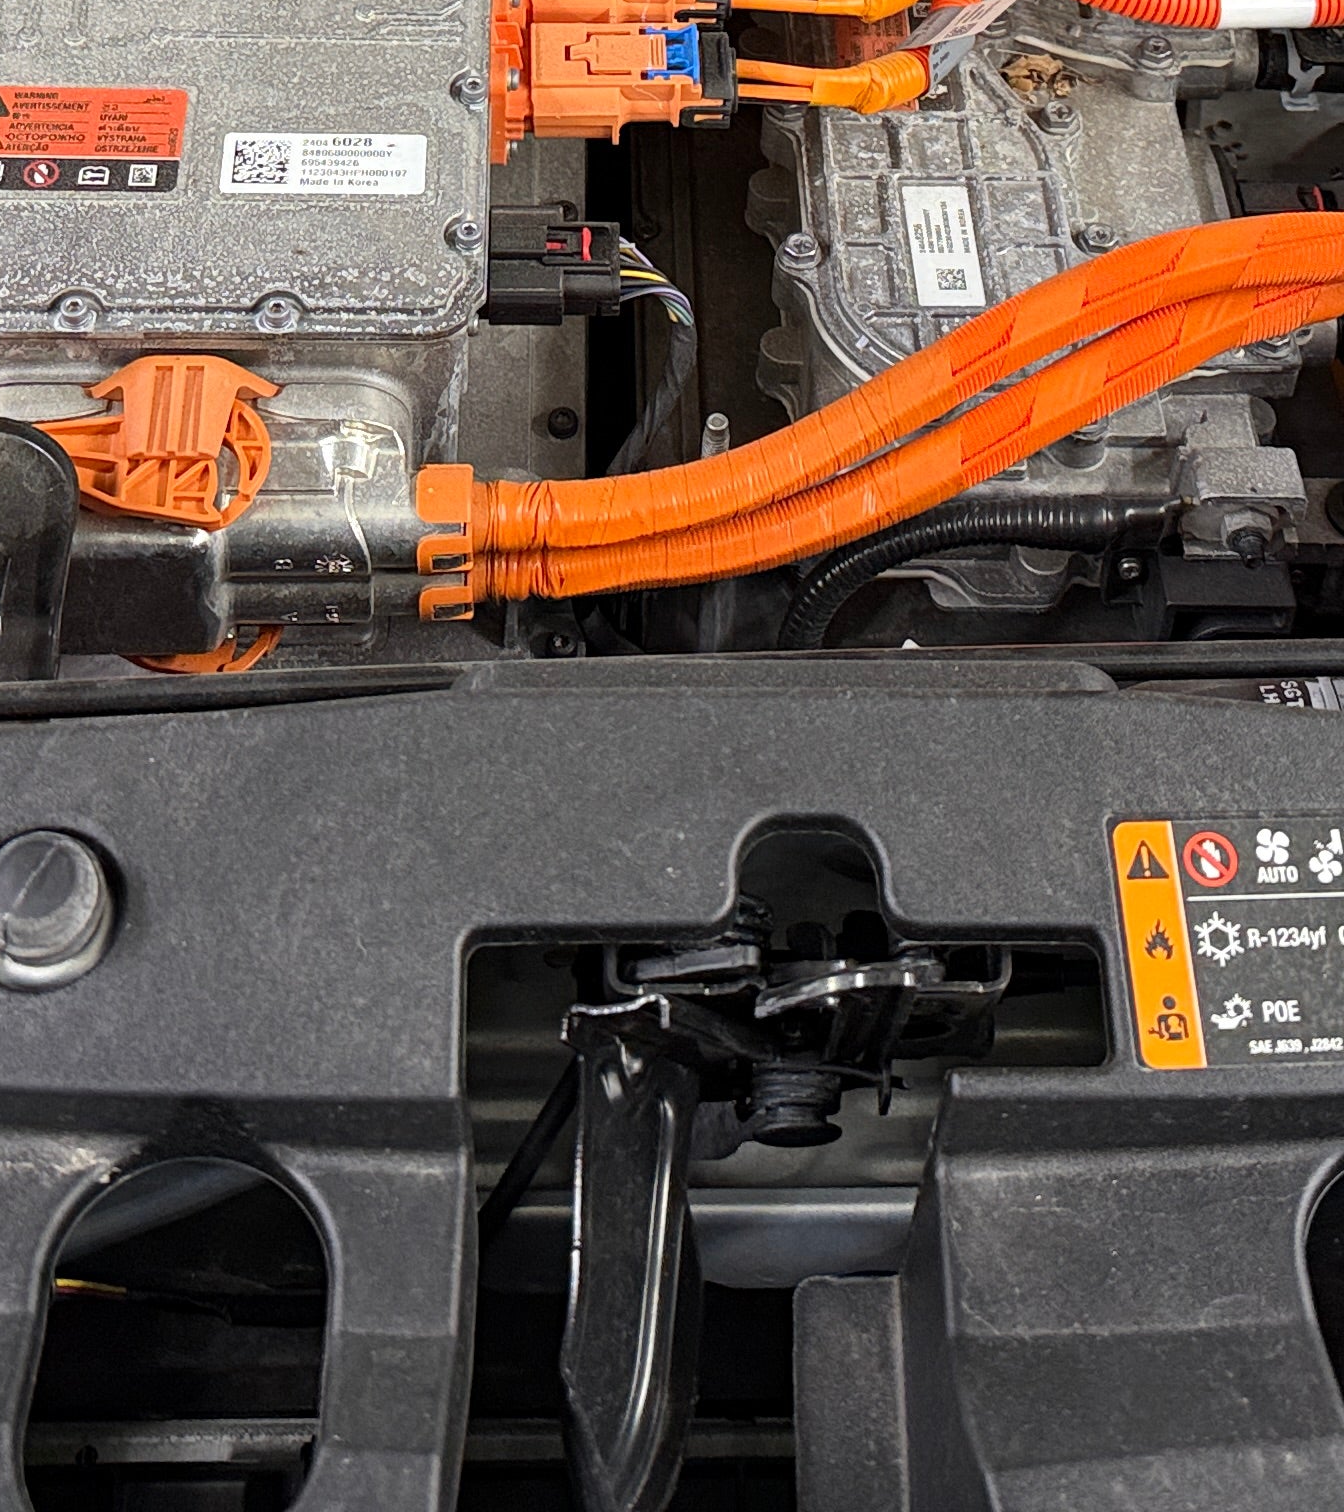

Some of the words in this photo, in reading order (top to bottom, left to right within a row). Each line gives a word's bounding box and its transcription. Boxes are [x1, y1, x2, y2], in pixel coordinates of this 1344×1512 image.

[332, 137, 373, 147] 6028
[300, 178, 329, 186] Made
[348, 178, 379, 186] Korea
[1257, 865, 1299, 884] AUTO
[1247, 925, 1328, 950] R-1234yf
[1262, 1000, 1302, 1023] POE
[1249, 1039, 1273, 1054] SAE
